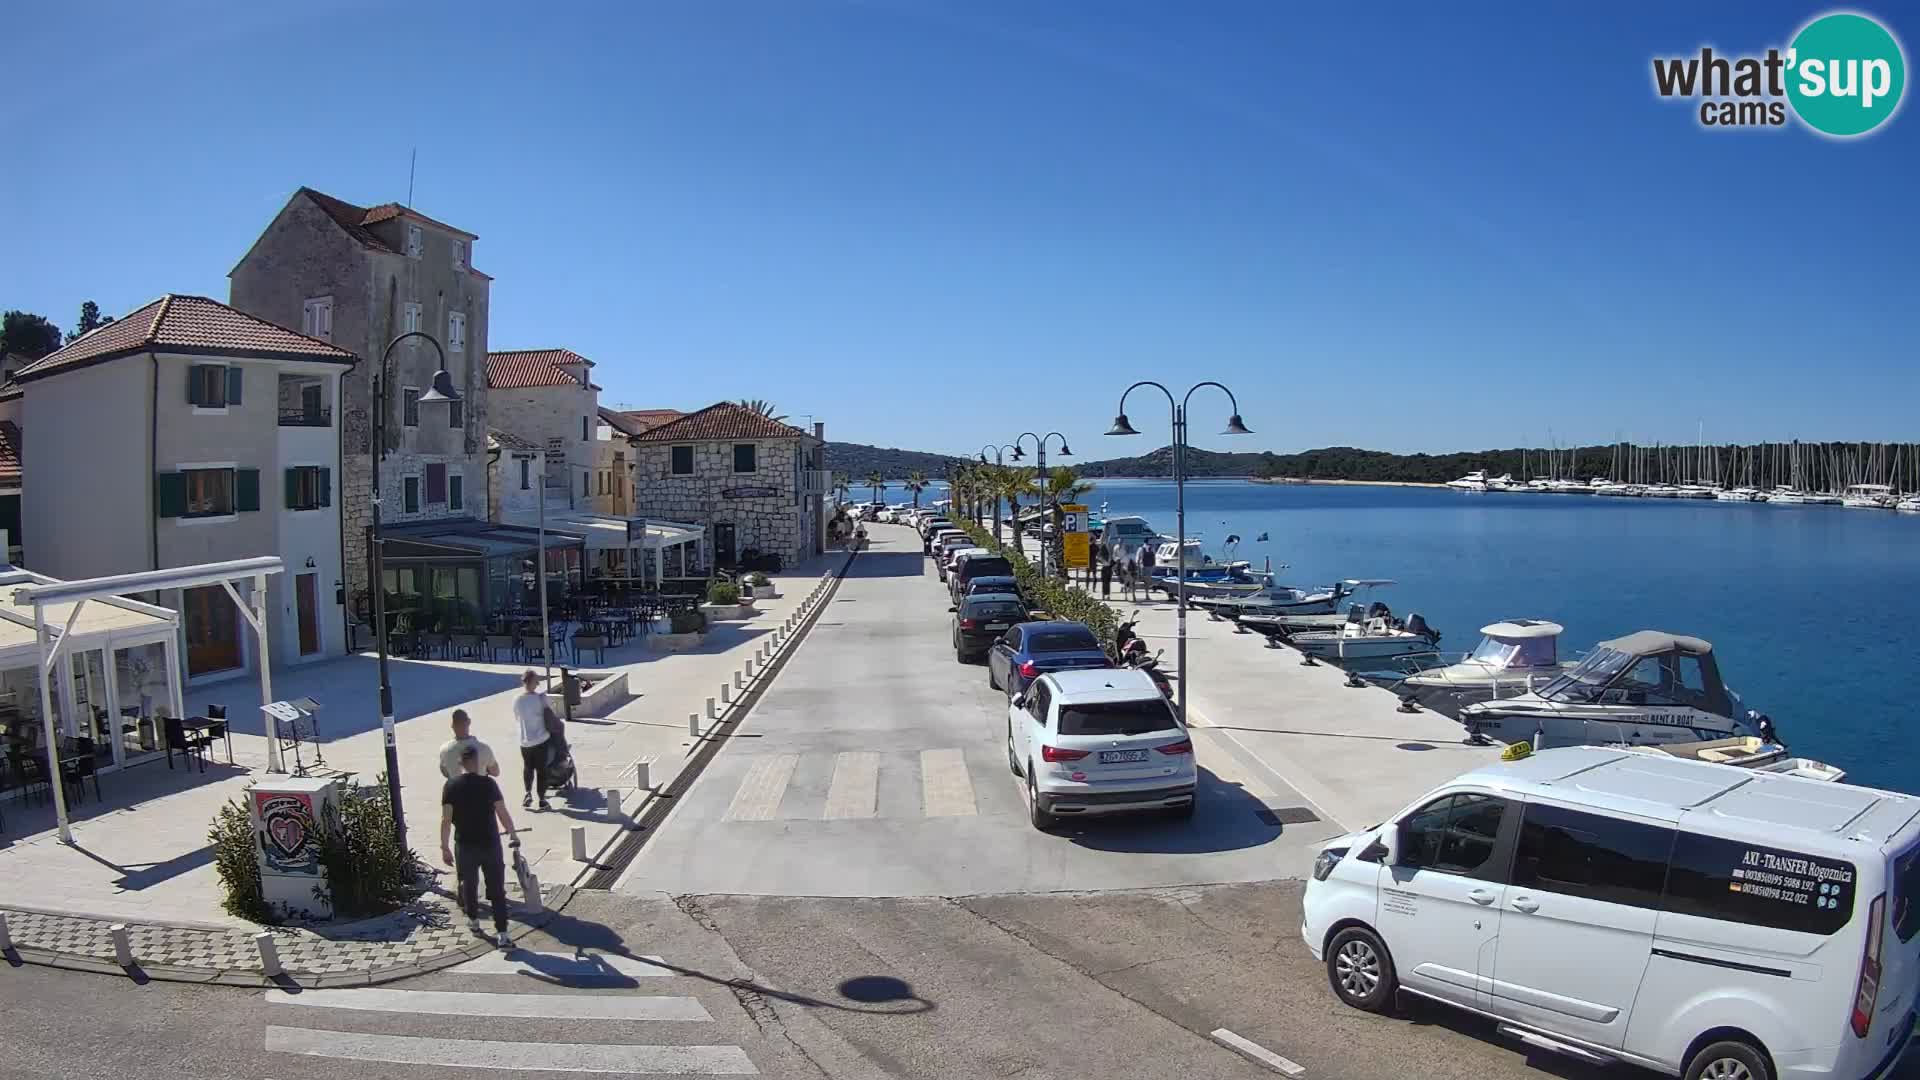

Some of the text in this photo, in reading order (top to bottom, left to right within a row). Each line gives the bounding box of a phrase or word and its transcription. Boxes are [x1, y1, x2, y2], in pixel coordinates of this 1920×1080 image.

[1065, 514, 1076, 530] P
[1650, 713, 1671, 725] RENT
[1808, 861, 1852, 883] Rogoznica
